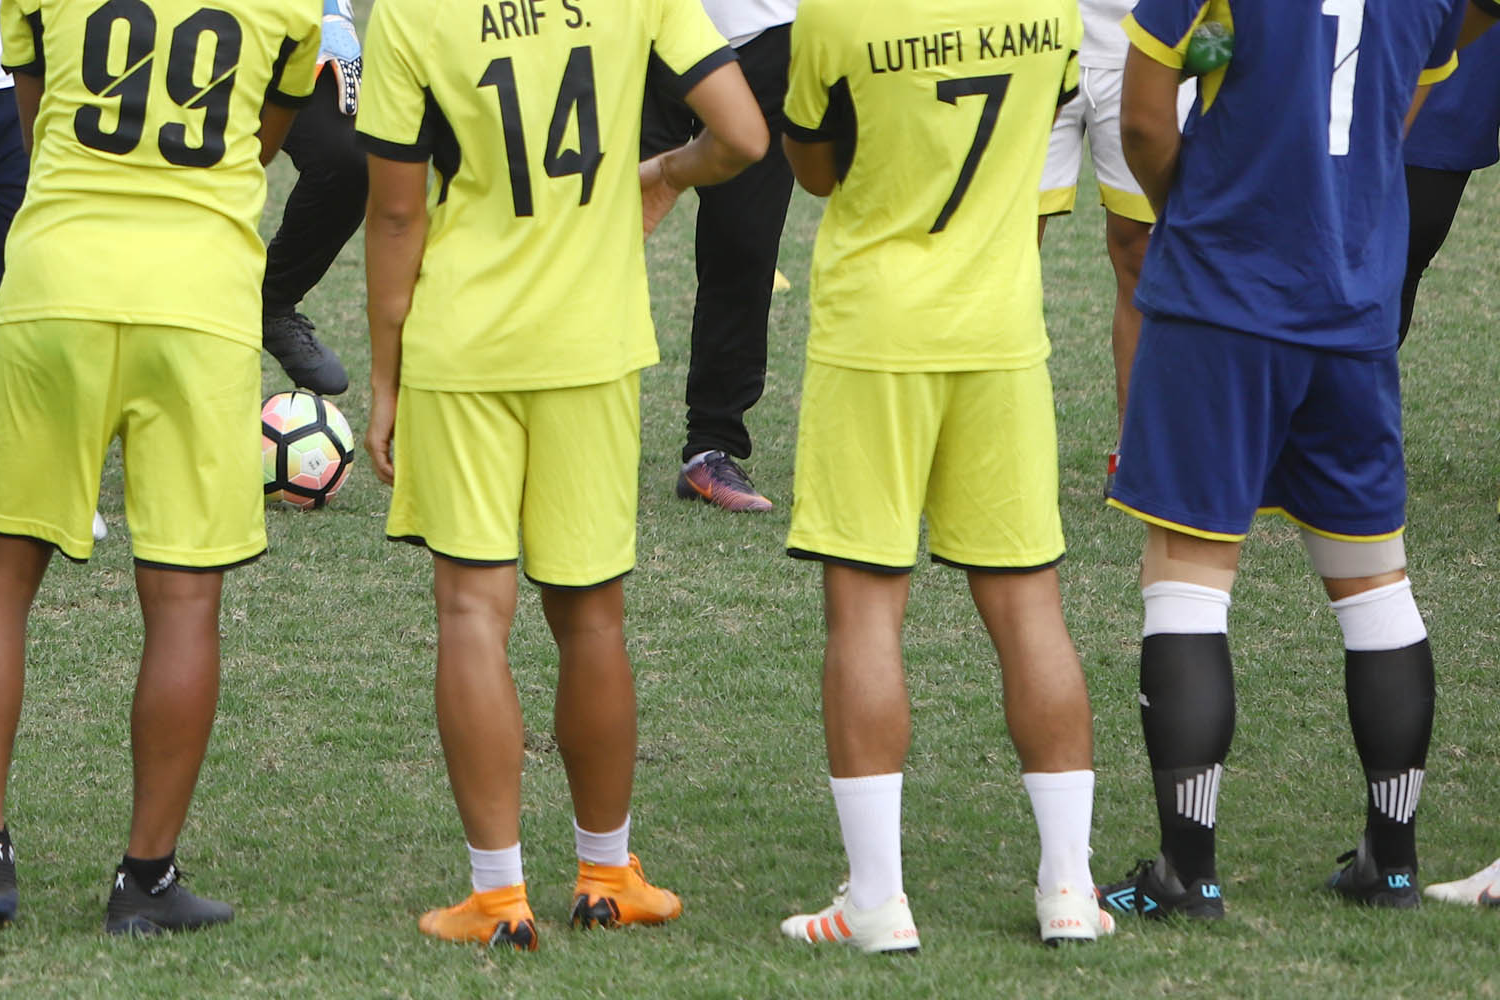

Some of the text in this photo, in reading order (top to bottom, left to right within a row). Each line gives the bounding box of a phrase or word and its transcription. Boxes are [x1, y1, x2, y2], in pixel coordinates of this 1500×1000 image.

[867, 17, 1063, 74] LUTHFI KAMAL
[476, 45, 605, 217] 14
[936, 73, 1013, 234] 7
[1050, 920, 1082, 929] COPA
